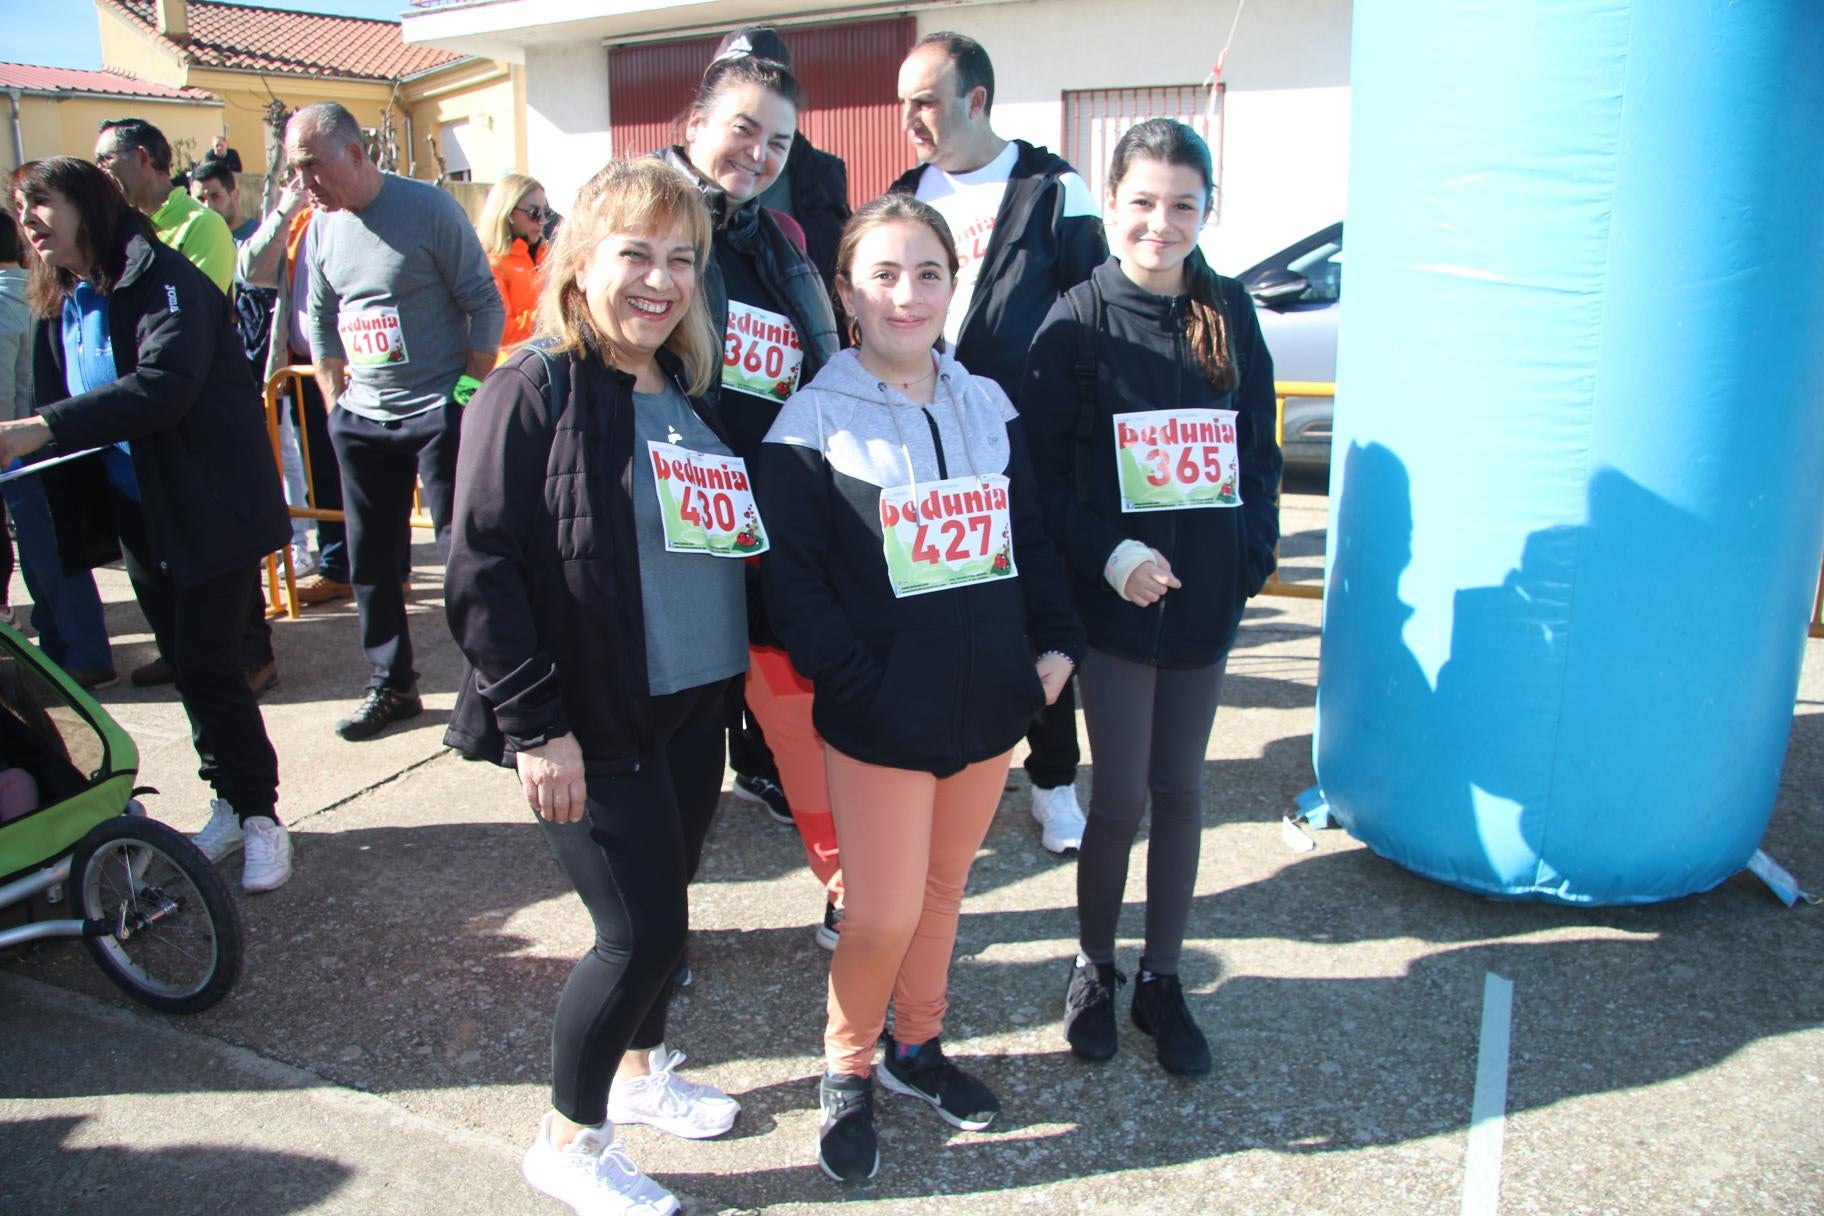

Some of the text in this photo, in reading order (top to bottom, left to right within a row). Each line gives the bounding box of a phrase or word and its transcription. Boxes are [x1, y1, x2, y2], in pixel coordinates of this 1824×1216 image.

[353, 331, 389, 354] 410
[726, 312, 804, 351] edunia
[723, 332, 784, 379] 360
[1117, 417, 1235, 450] bedunia
[652, 450, 749, 492] bedunia
[1146, 446, 1222, 487] 365
[680, 486, 736, 532] 430
[881, 483, 1007, 528] bedunia
[911, 514, 992, 565] 427
